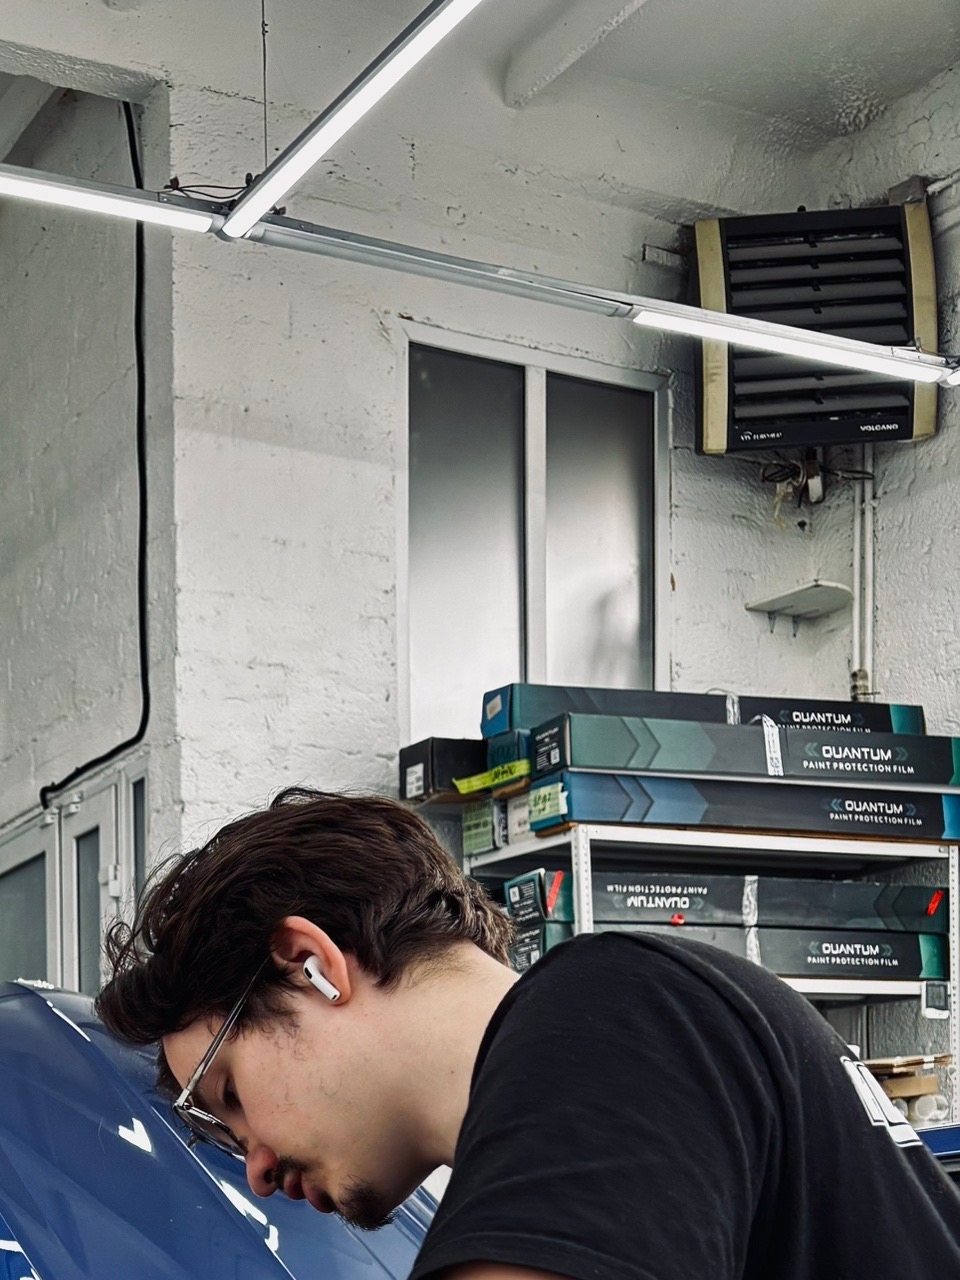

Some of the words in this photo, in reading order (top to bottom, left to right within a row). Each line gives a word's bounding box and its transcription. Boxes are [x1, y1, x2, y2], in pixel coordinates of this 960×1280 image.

[860, 423, 899, 432] VOLCANO
[792, 711, 851, 724] QUANTUM
[821, 746, 892, 761] QUANTUM
[803, 760, 831, 770] PAINT
[833, 761, 890, 773] PROTECTION
[893, 765, 915, 774] FILM
[844, 800, 903, 814] QUANTUM
[829, 812, 853, 821] PAINT
[854, 814, 903, 825] PROTECTION
[904, 817, 922, 826] FILM
[606, 884, 627, 893] FILM
[628, 884, 682, 894] PROTECTION
[683, 886, 708, 895] PAINT
[626, 895, 690, 909] QUANTUM
[821, 942, 879, 956] QUANTUM
[807, 956, 830, 964] PAINT
[831, 956, 879, 966] PROTECTION
[880, 958, 899, 966] FILM
